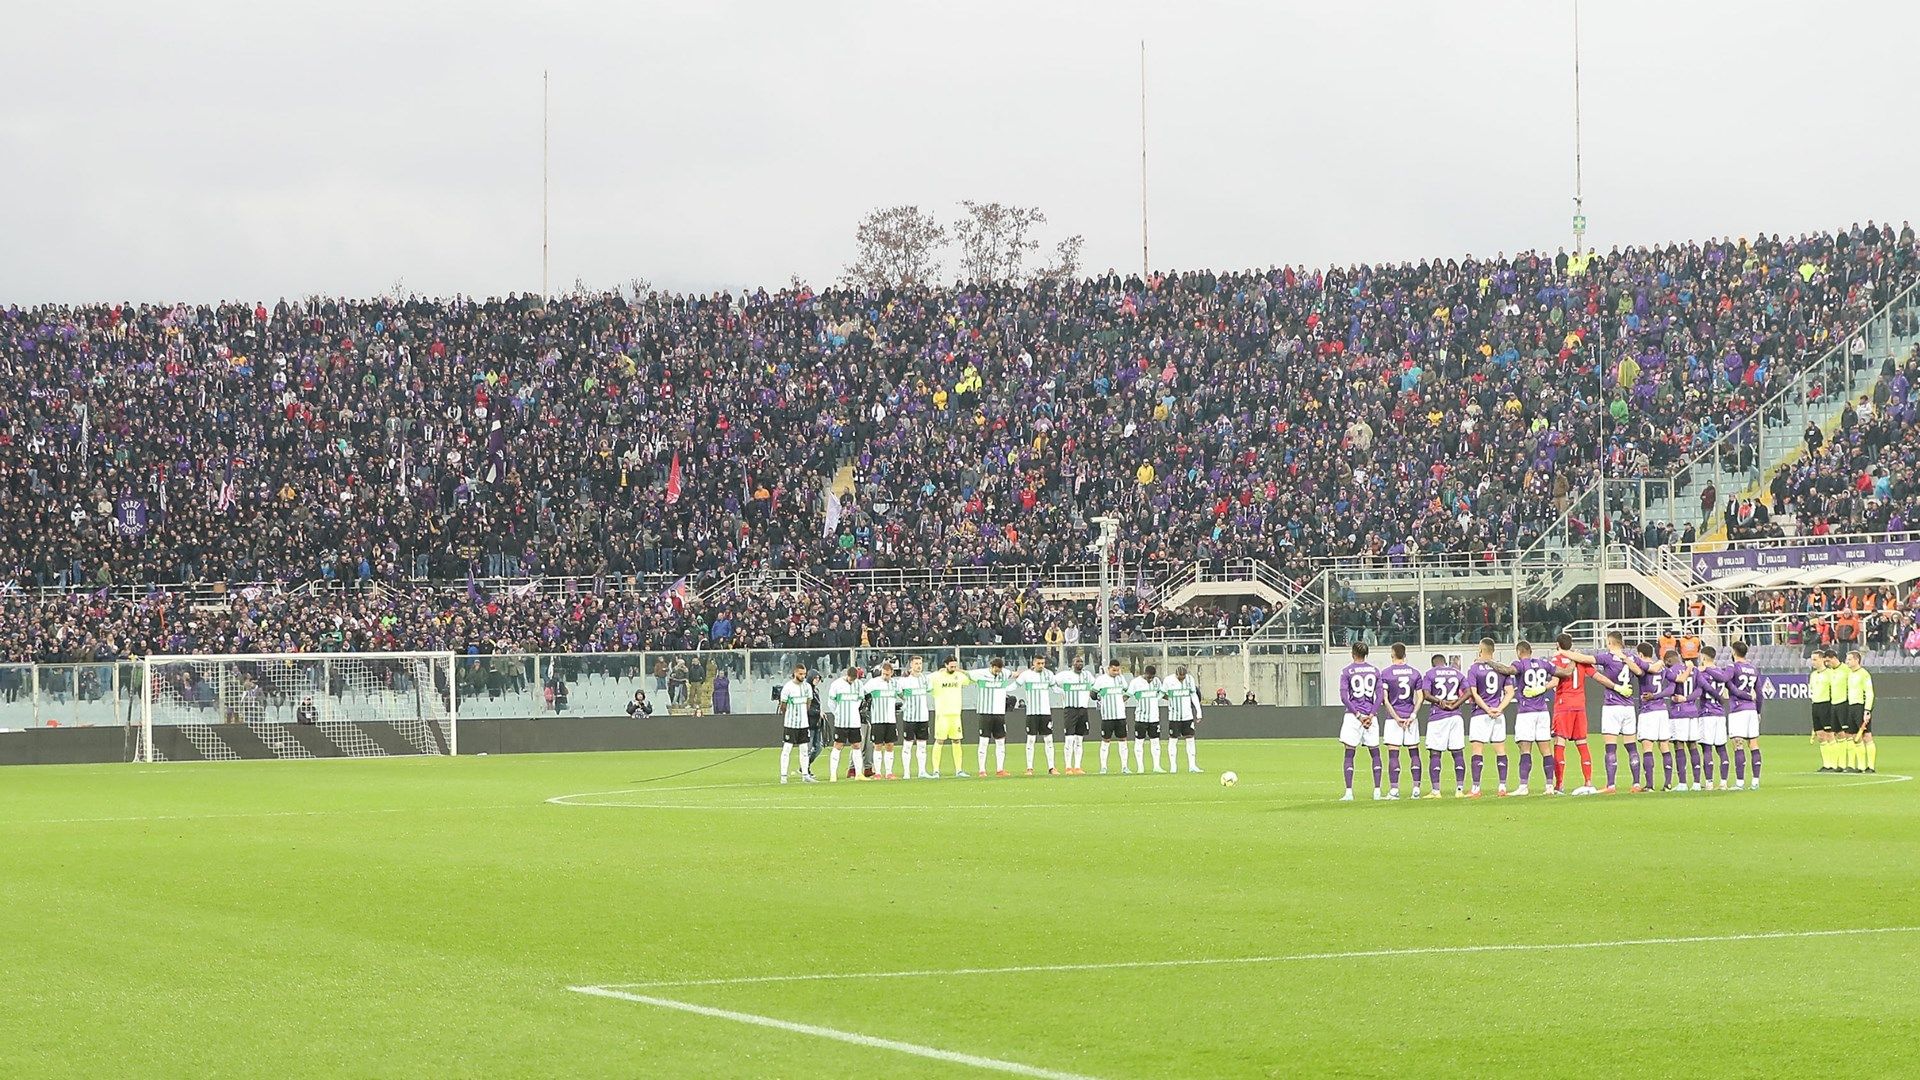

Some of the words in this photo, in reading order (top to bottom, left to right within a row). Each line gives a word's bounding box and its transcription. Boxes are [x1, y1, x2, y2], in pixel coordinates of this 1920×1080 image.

[1350, 674, 1376, 698] 99
[1485, 671, 1499, 694] 9
[1524, 668, 1547, 689] 98
[1618, 664, 1630, 685] 4
[1652, 675, 1662, 695] 5
[1398, 676, 1411, 700] 3
[1434, 677, 1459, 700] 32
